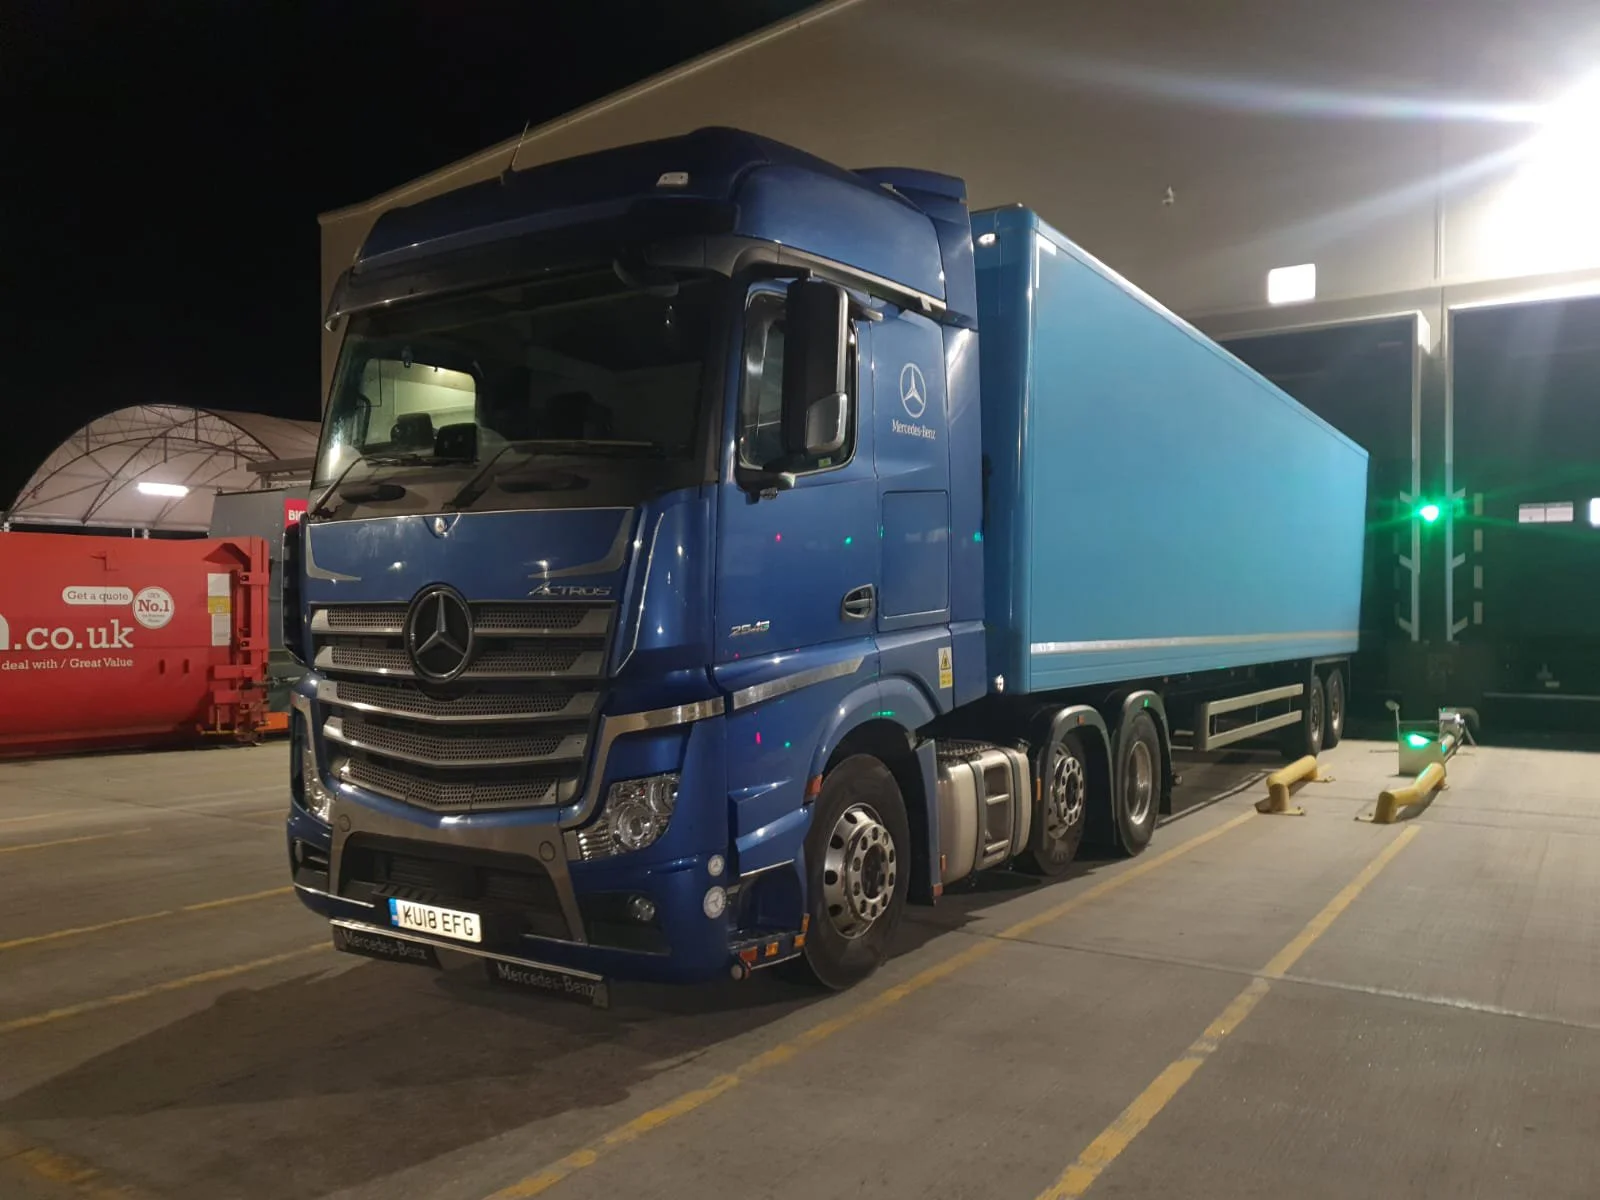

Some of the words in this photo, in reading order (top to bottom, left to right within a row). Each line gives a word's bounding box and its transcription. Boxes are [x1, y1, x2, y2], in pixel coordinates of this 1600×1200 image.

[892, 418, 936, 440] Mercedes-Benz
[67, 590, 87, 600] Get
[90, 592, 97, 600] a
[99, 592, 129, 603] quote
[138, 599, 170, 613] No.1
[1, 660, 29, 671] deal
[32, 659, 58, 670] with
[69, 658, 101, 669] Great
[103, 657, 133, 668] Value
[402, 904, 438, 930] KU18
[441, 912, 473, 937] EFG
[496, 961, 595, 997] Mercedes-Benz
